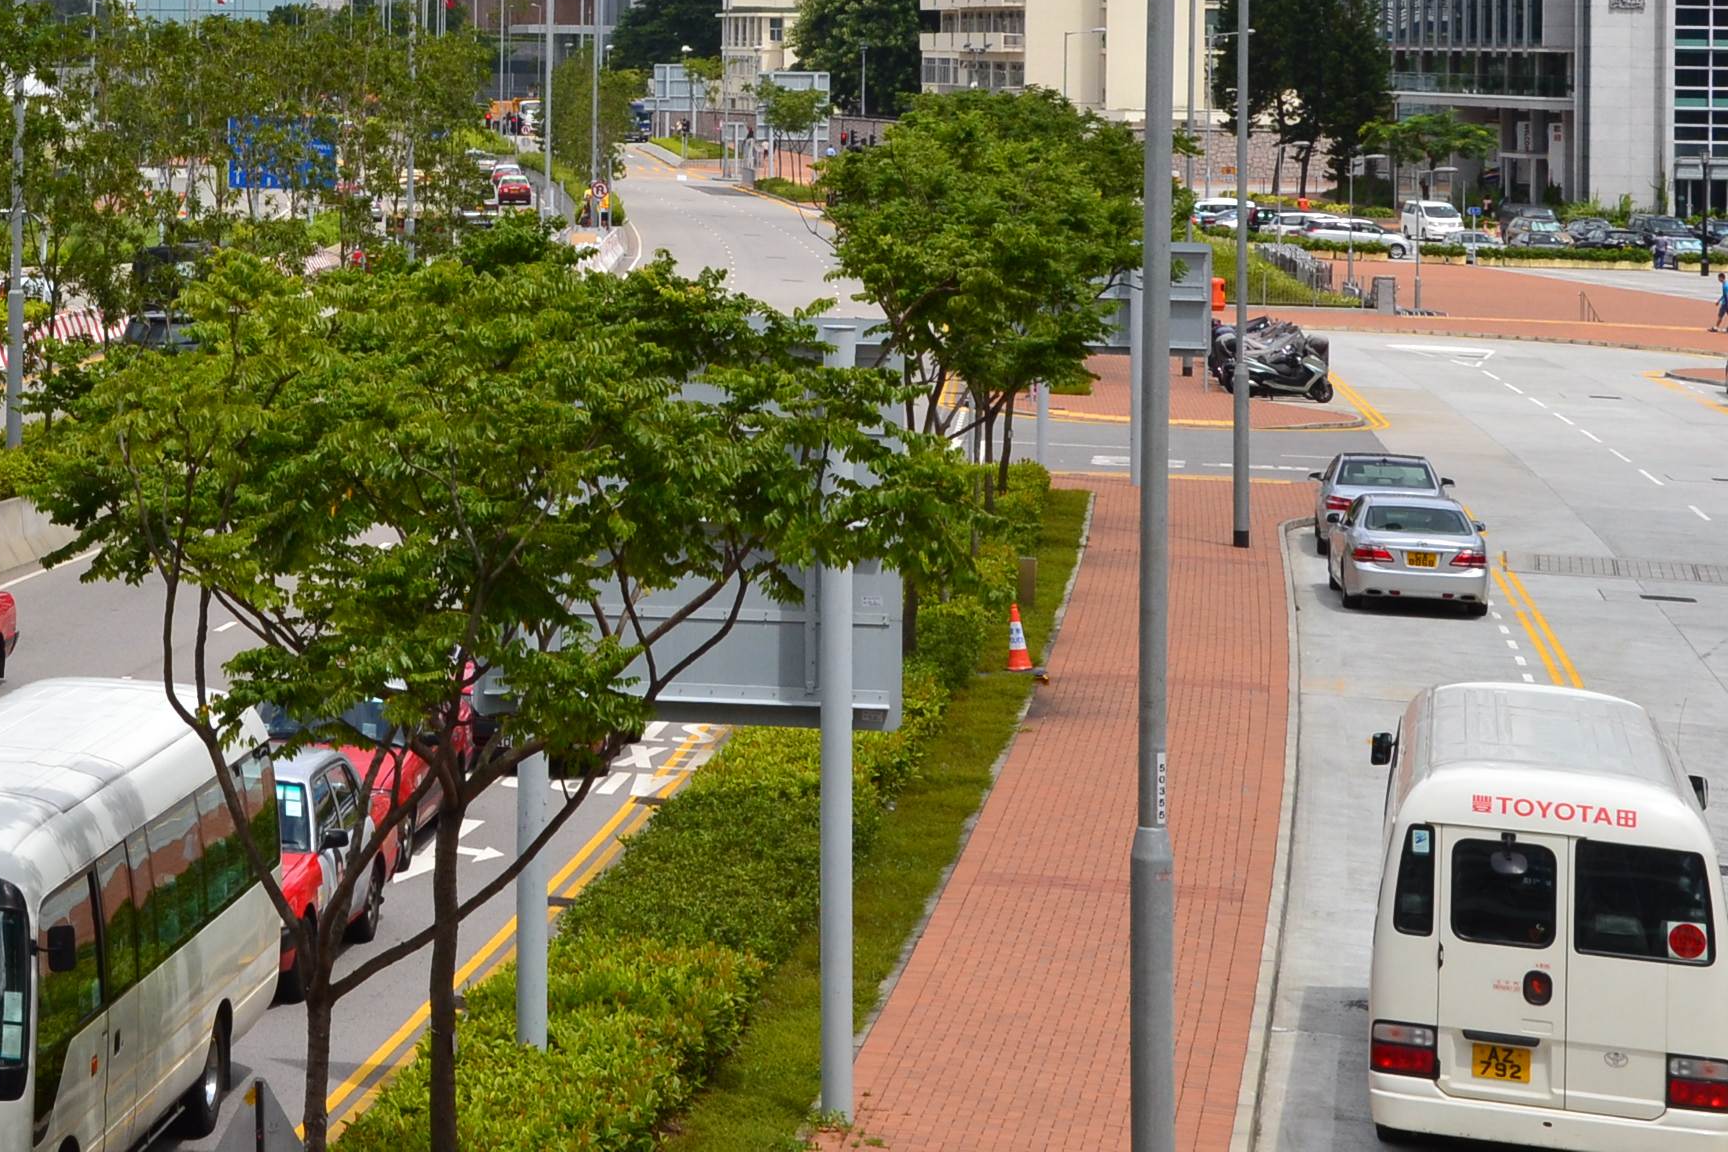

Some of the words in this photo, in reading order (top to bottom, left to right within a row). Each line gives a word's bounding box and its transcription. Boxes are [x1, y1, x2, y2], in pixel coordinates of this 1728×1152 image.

[1496, 796, 1613, 825] TOYOTA
[1616, 809, 1637, 828] 田
[1488, 1048, 1514, 1064] AZ
[1480, 1060, 1521, 1080] 792
